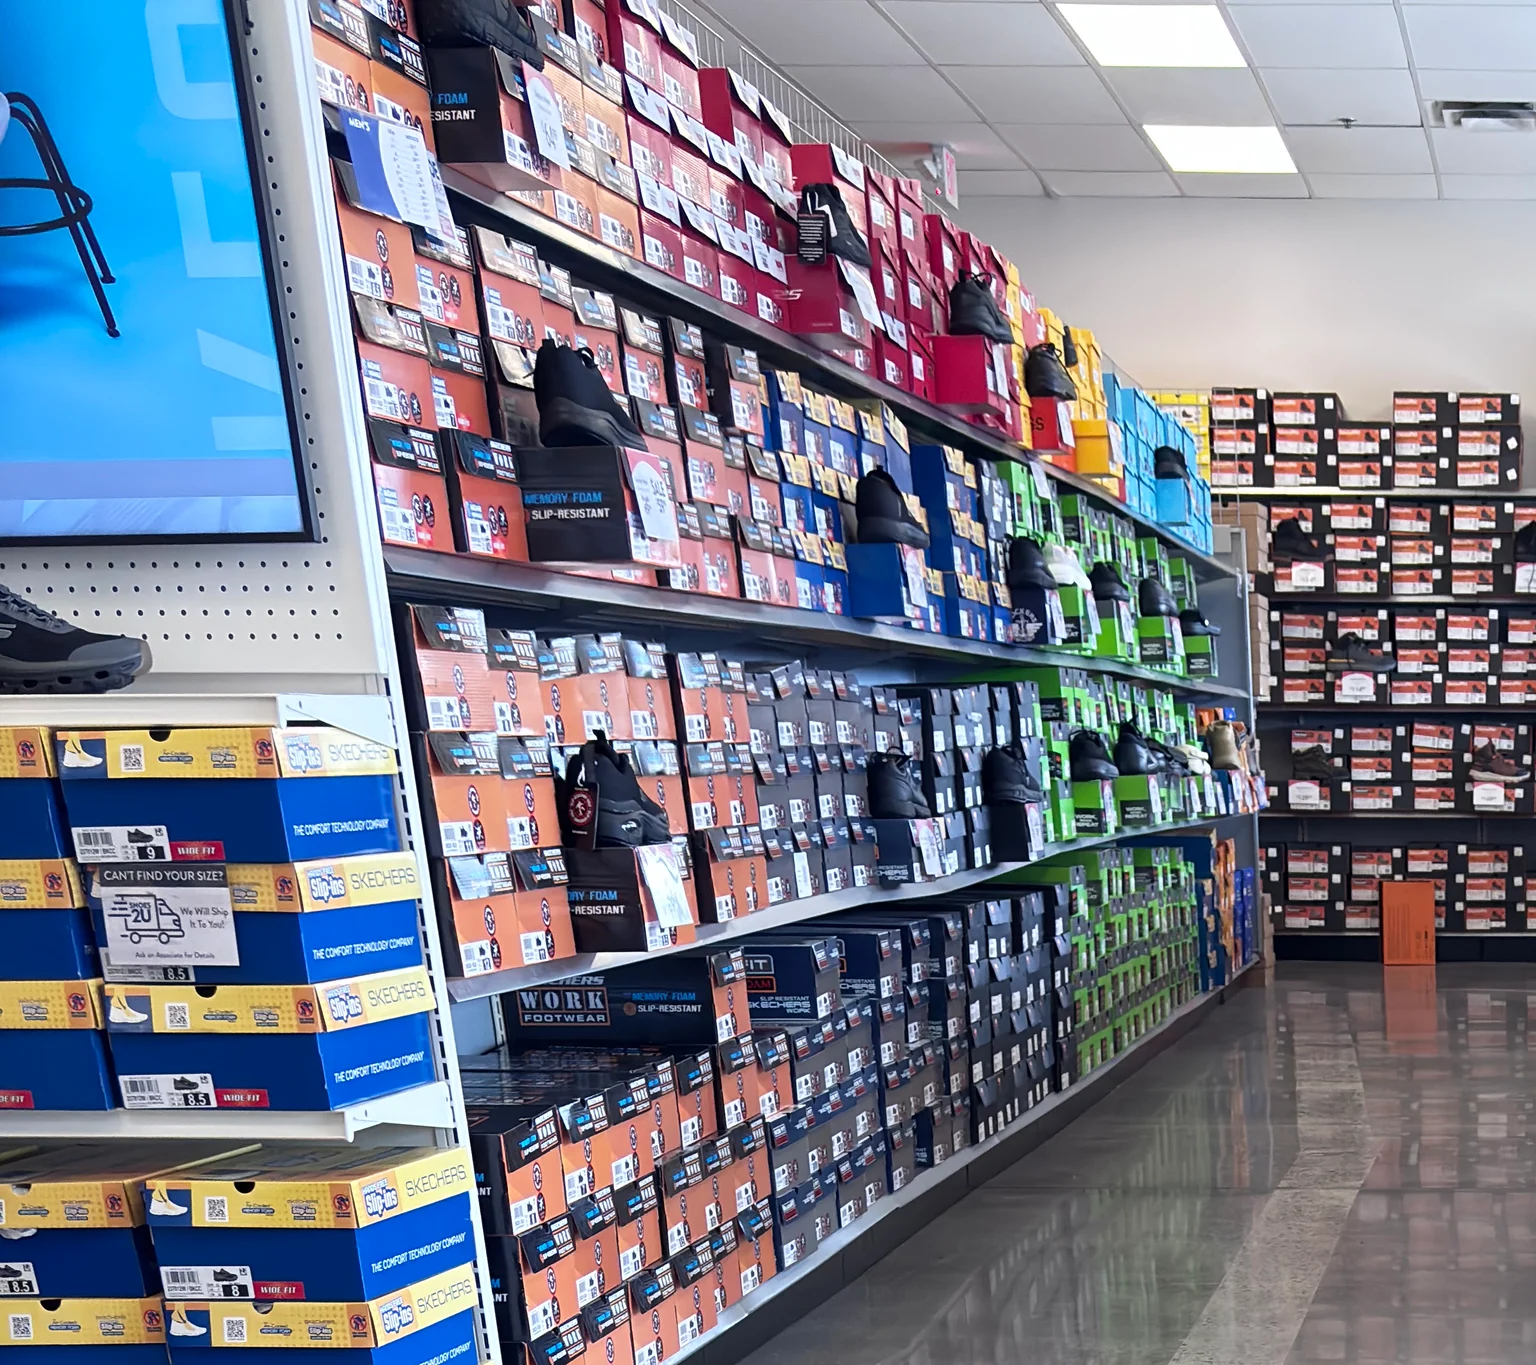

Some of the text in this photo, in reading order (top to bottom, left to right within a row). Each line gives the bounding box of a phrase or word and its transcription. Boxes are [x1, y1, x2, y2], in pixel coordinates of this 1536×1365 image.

[438, 93, 468, 105] FOAM
[348, 117, 370, 132] MEN'S
[524, 492, 603, 504] MEMORY FOAM
[532, 508, 610, 520] SLIP-RESISTANT
[328, 742, 390, 761] SKECHERS
[289, 746, 322, 771] Slip-ins
[293, 818, 390, 836] THE COMFORT TECHNOLOGY COMPANY
[146, 848, 155, 860] 9
[178, 847, 216, 856] WIDE FIT
[103, 870, 224, 881] CAN'T FIND YOUR SIZE?
[351, 867, 416, 890] SKECHERS
[310, 876, 346, 902] Slip-ins
[590, 890, 618, 901] FOAM
[131, 908, 152, 923] 2U
[180, 906, 229, 918] We Will Ship
[189, 920, 225, 929] It To You!
[312, 936, 415, 960] THE COMFORT TECHNOLOGY COMPANY
[194, 951, 215, 959] Details
[167, 968, 186, 980] 8.5
[368, 981, 426, 1007] SKECHERS
[631, 992, 697, 1001] MEMORY FOAM
[520, 991, 605, 1010] WORK
[329, 995, 363, 1022] Slip-ins
[637, 1004, 702, 1013] SLIP-RESISTANT
[524, 1013, 606, 1023] FOOTWEAR
[334, 1051, 424, 1083] THE COMFORT TECHNOLOGY COMPANY
[10, 1095, 25, 1104] FIT
[188, 1094, 206, 1106] 8.5
[223, 1094, 260, 1102] WIDE FIT
[405, 1164, 467, 1197] SKECHERS
[365, 1187, 399, 1218] Slip-ins
[371, 1231, 466, 1274] THE COMFORT TECHNOLOGY COMPANY
[12, 1280, 30, 1293] 8.5
[231, 1285, 240, 1297] 8
[260, 1286, 297, 1294] WIDE FIT
[416, 1278, 473, 1314] SKECHERS
[381, 1305, 414, 1334] Slip-ins
[449, 1341, 471, 1359] COMPANY
